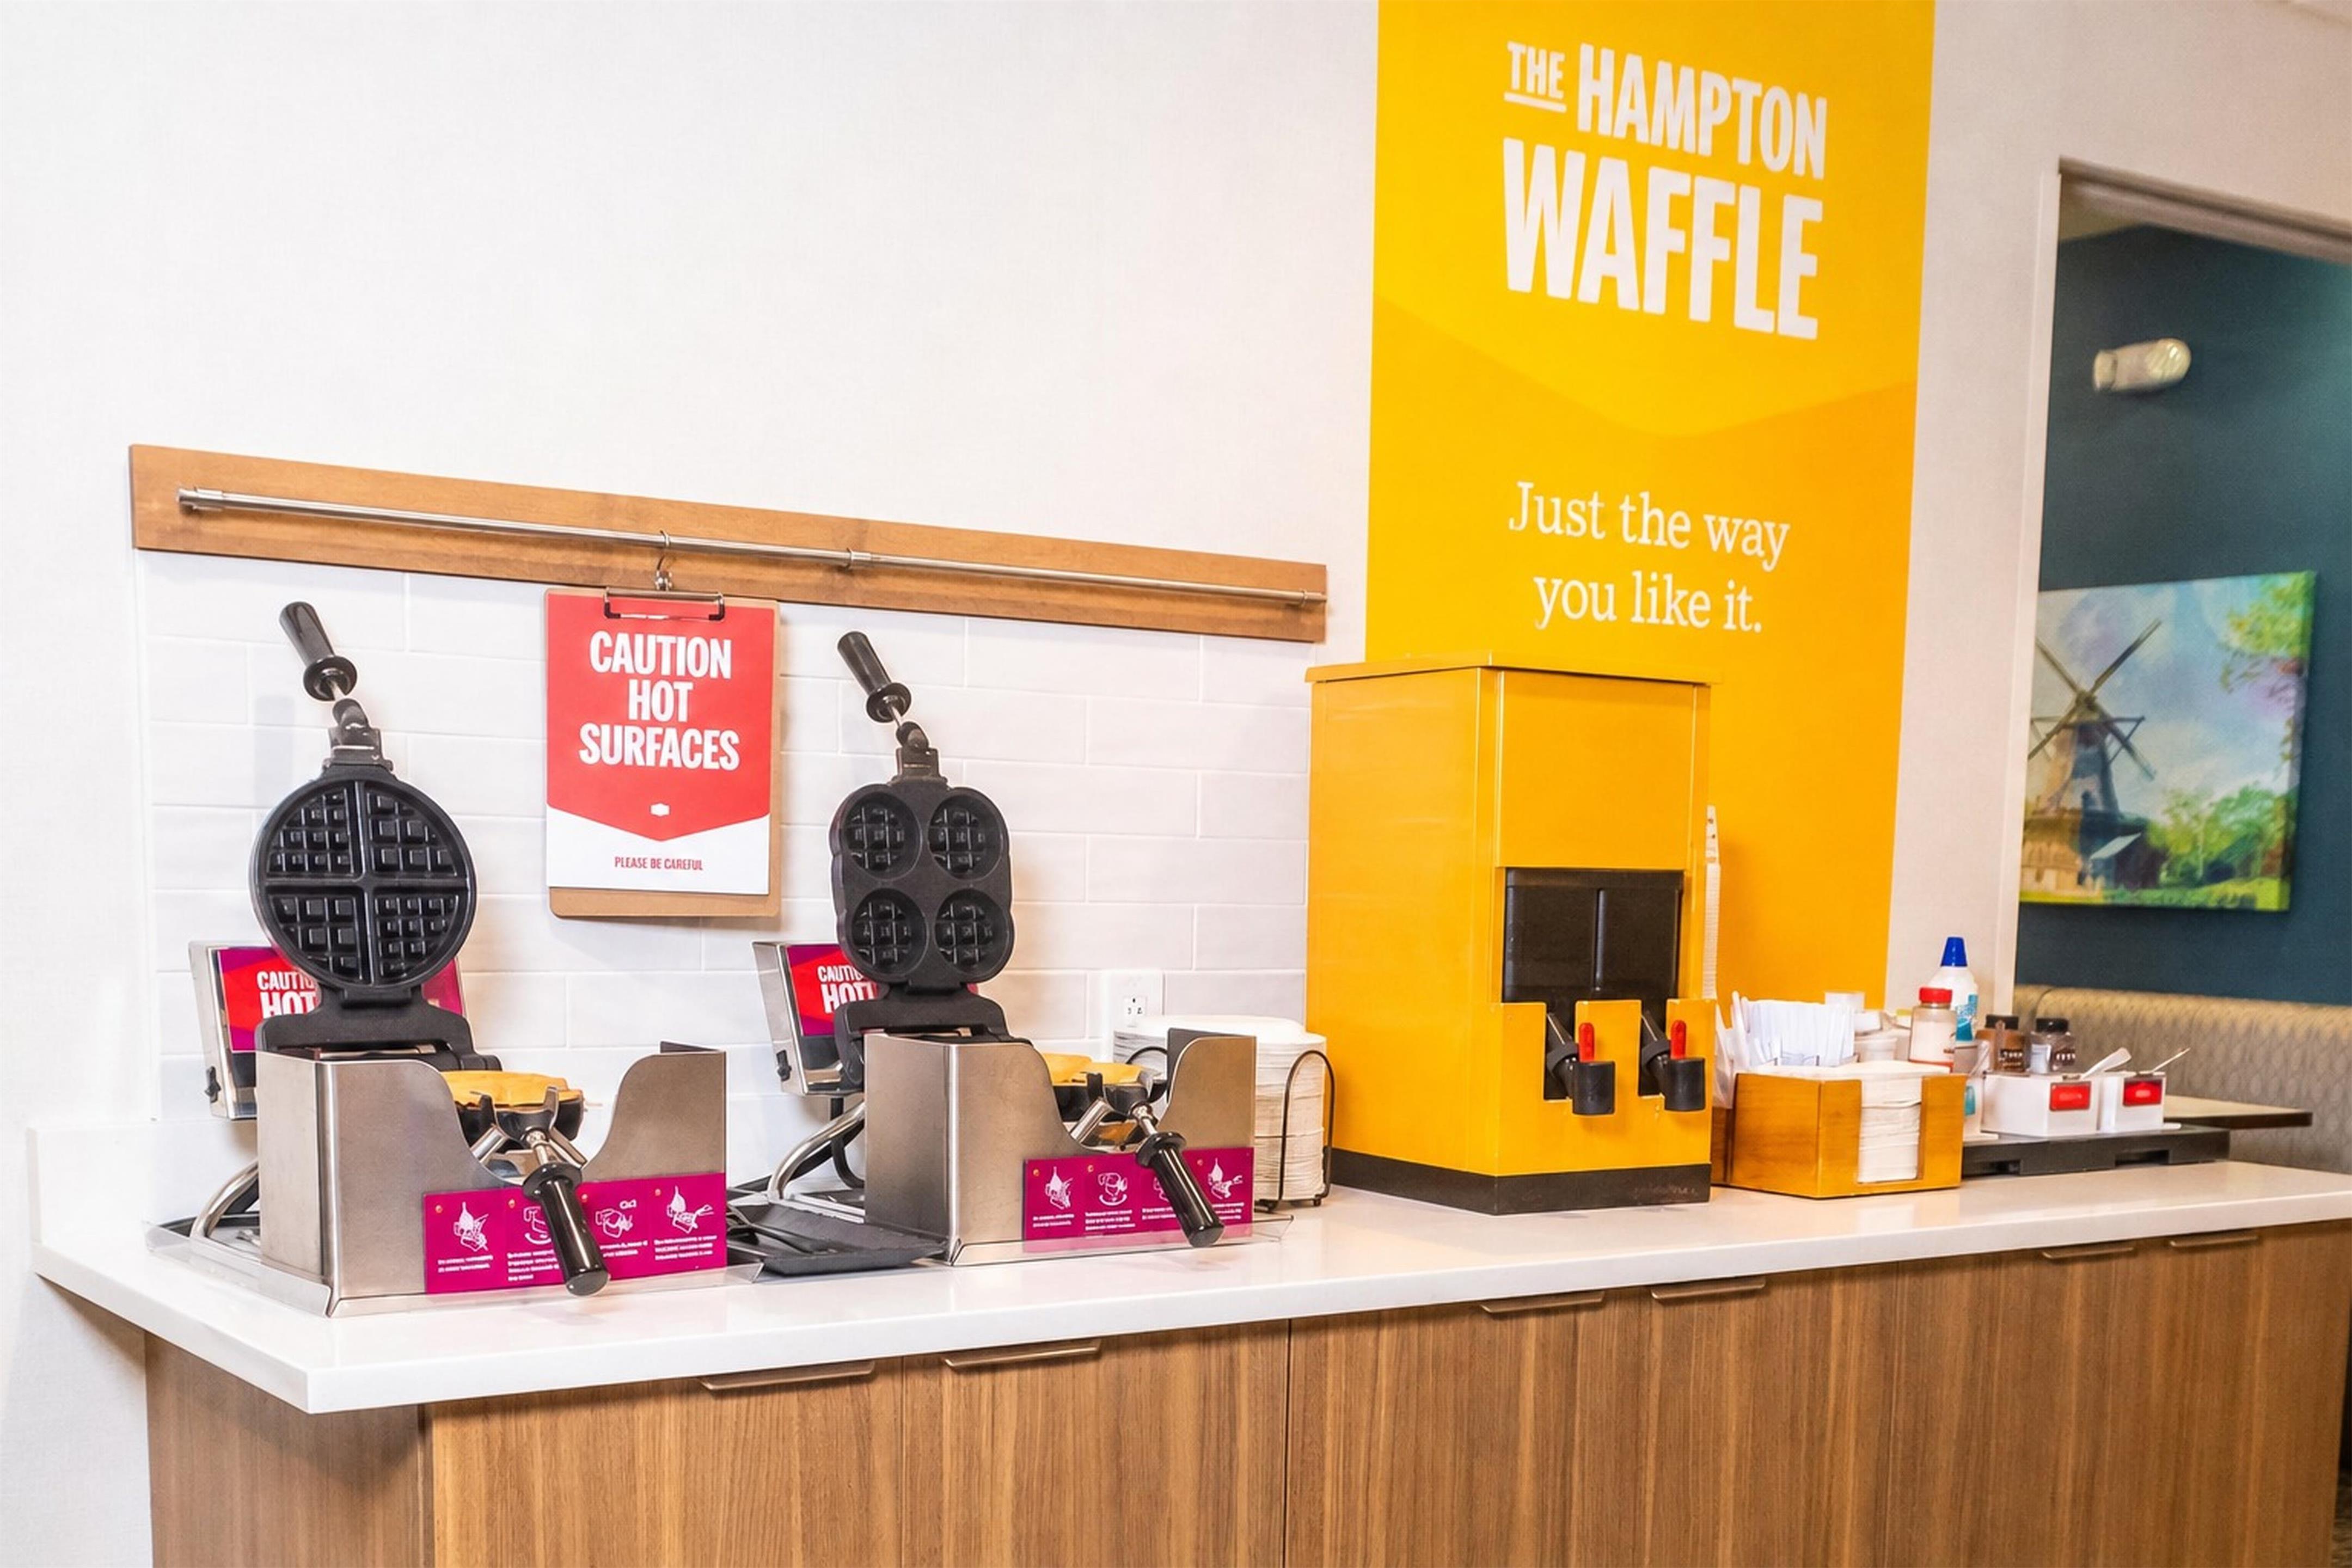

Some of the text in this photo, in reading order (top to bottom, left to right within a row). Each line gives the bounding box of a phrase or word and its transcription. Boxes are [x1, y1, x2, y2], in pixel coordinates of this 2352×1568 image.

[1506, 41, 1827, 180] THE HAMPTON
[1503, 137, 1823, 340] WAFFLE
[1509, 481, 1791, 573] Just the way
[1533, 570, 1762, 633] you like it.
[590, 630, 732, 679] CAUTION
[628, 679, 694, 722] HOT
[579, 723, 740, 771] SURFACES
[614, 856, 703, 871] PLEASE BE CAREFUL
[256, 970, 315, 990] CAUTIO
